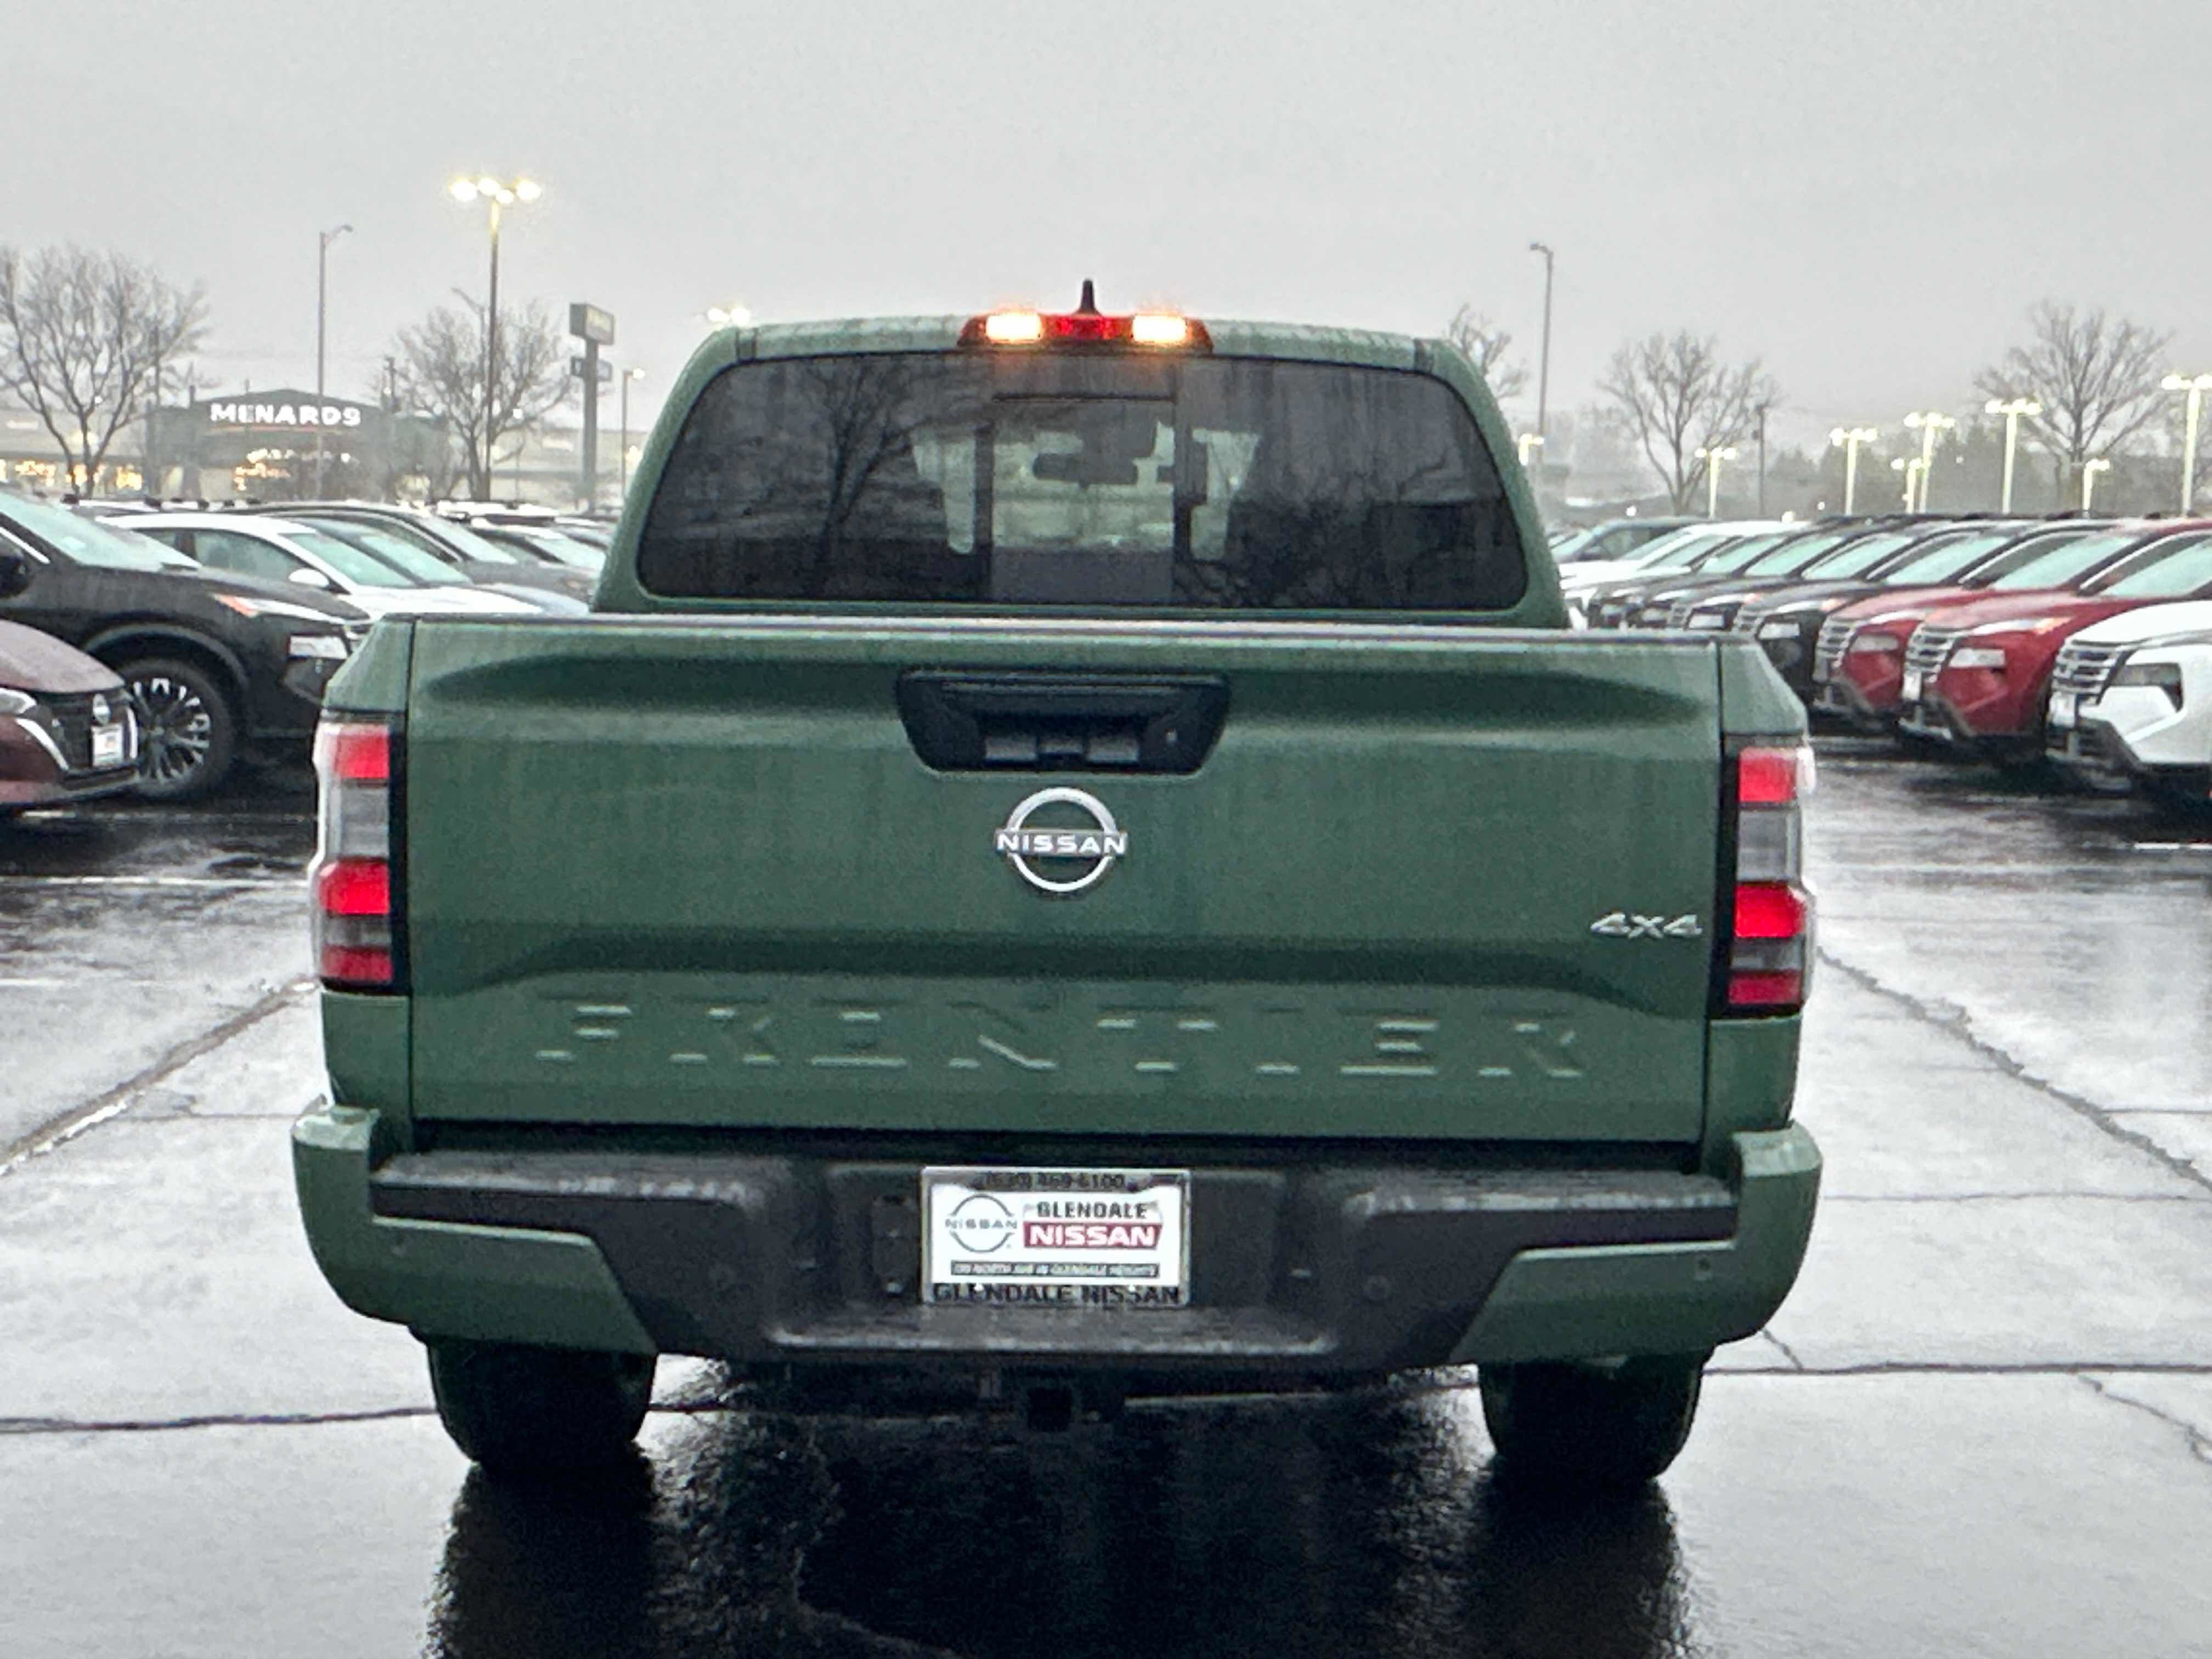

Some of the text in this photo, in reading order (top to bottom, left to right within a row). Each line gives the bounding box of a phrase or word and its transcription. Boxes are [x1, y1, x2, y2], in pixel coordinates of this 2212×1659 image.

[211, 403, 361, 426] MENARDS
[996, 832, 1127, 854] NISSAN
[533, 991, 1583, 1079] FRONTIER
[1036, 1201, 1148, 1219] GLENDALE
[945, 1218, 1018, 1229] NISSAN
[1030, 1224, 1155, 1246] NISSAN
[933, 1283, 1180, 1305] GLENDALE NISSAN
